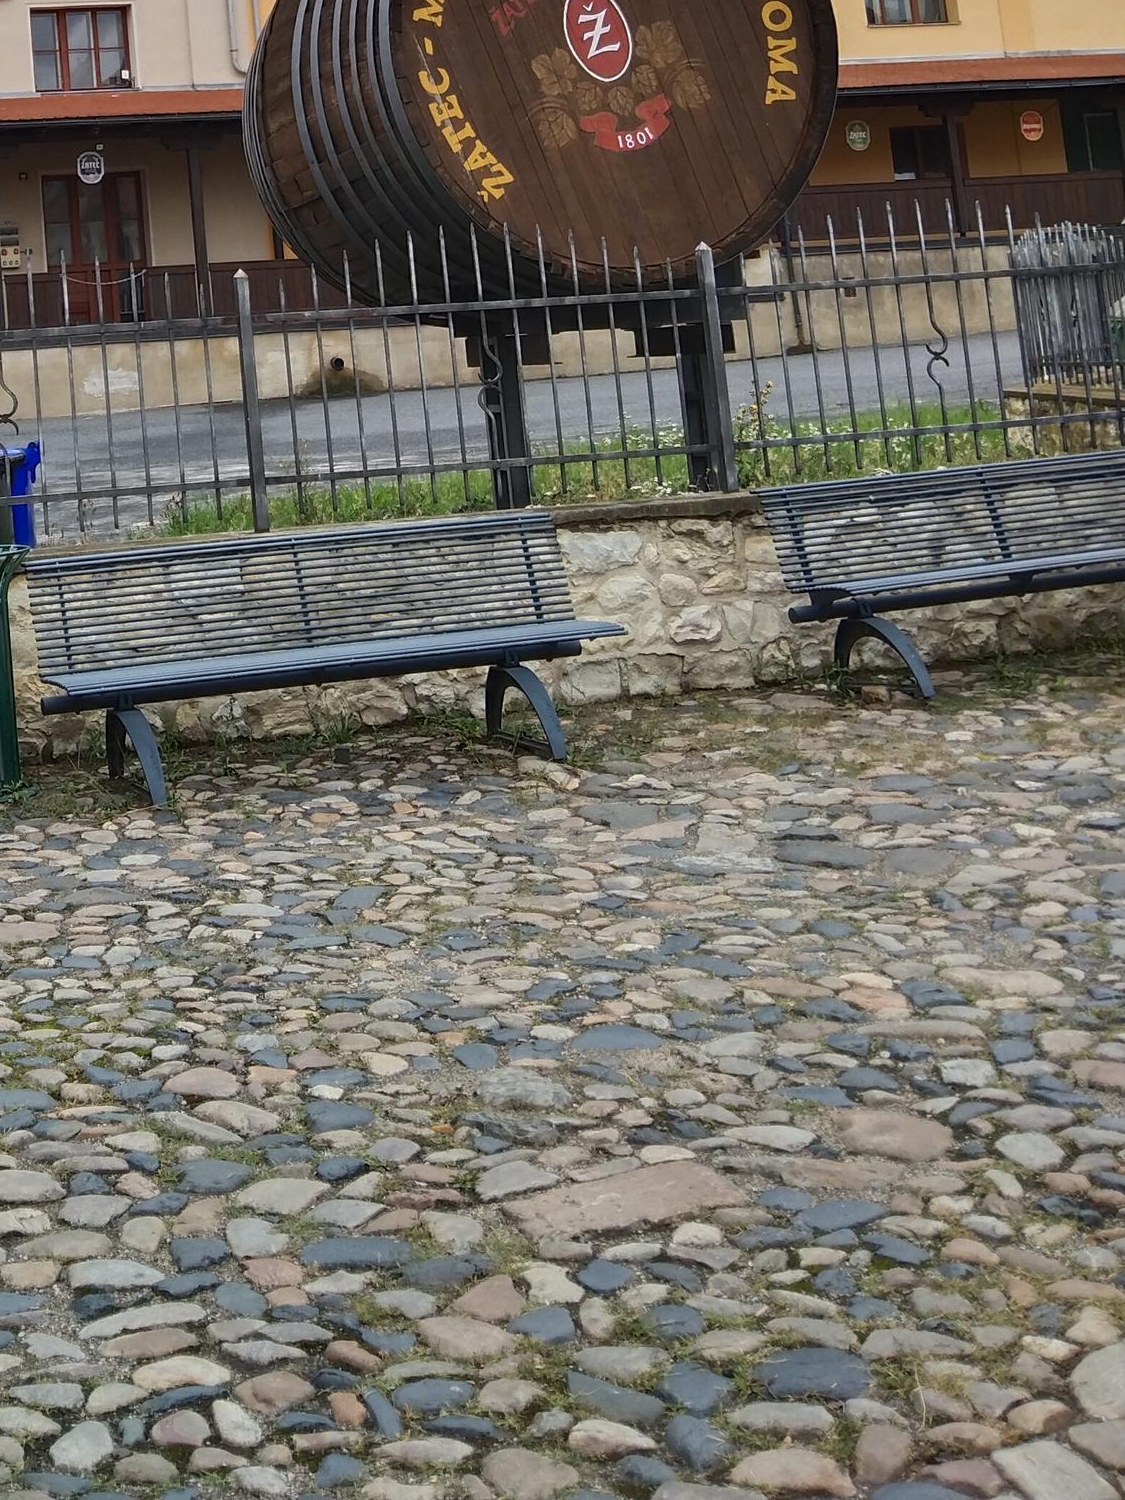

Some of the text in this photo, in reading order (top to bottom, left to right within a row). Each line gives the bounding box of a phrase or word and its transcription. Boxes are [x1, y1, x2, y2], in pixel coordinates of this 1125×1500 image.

[577, 1, 621, 60] Ž
[418, 67, 515, 203] ŽATEC
[617, 126, 654, 149] 1801
